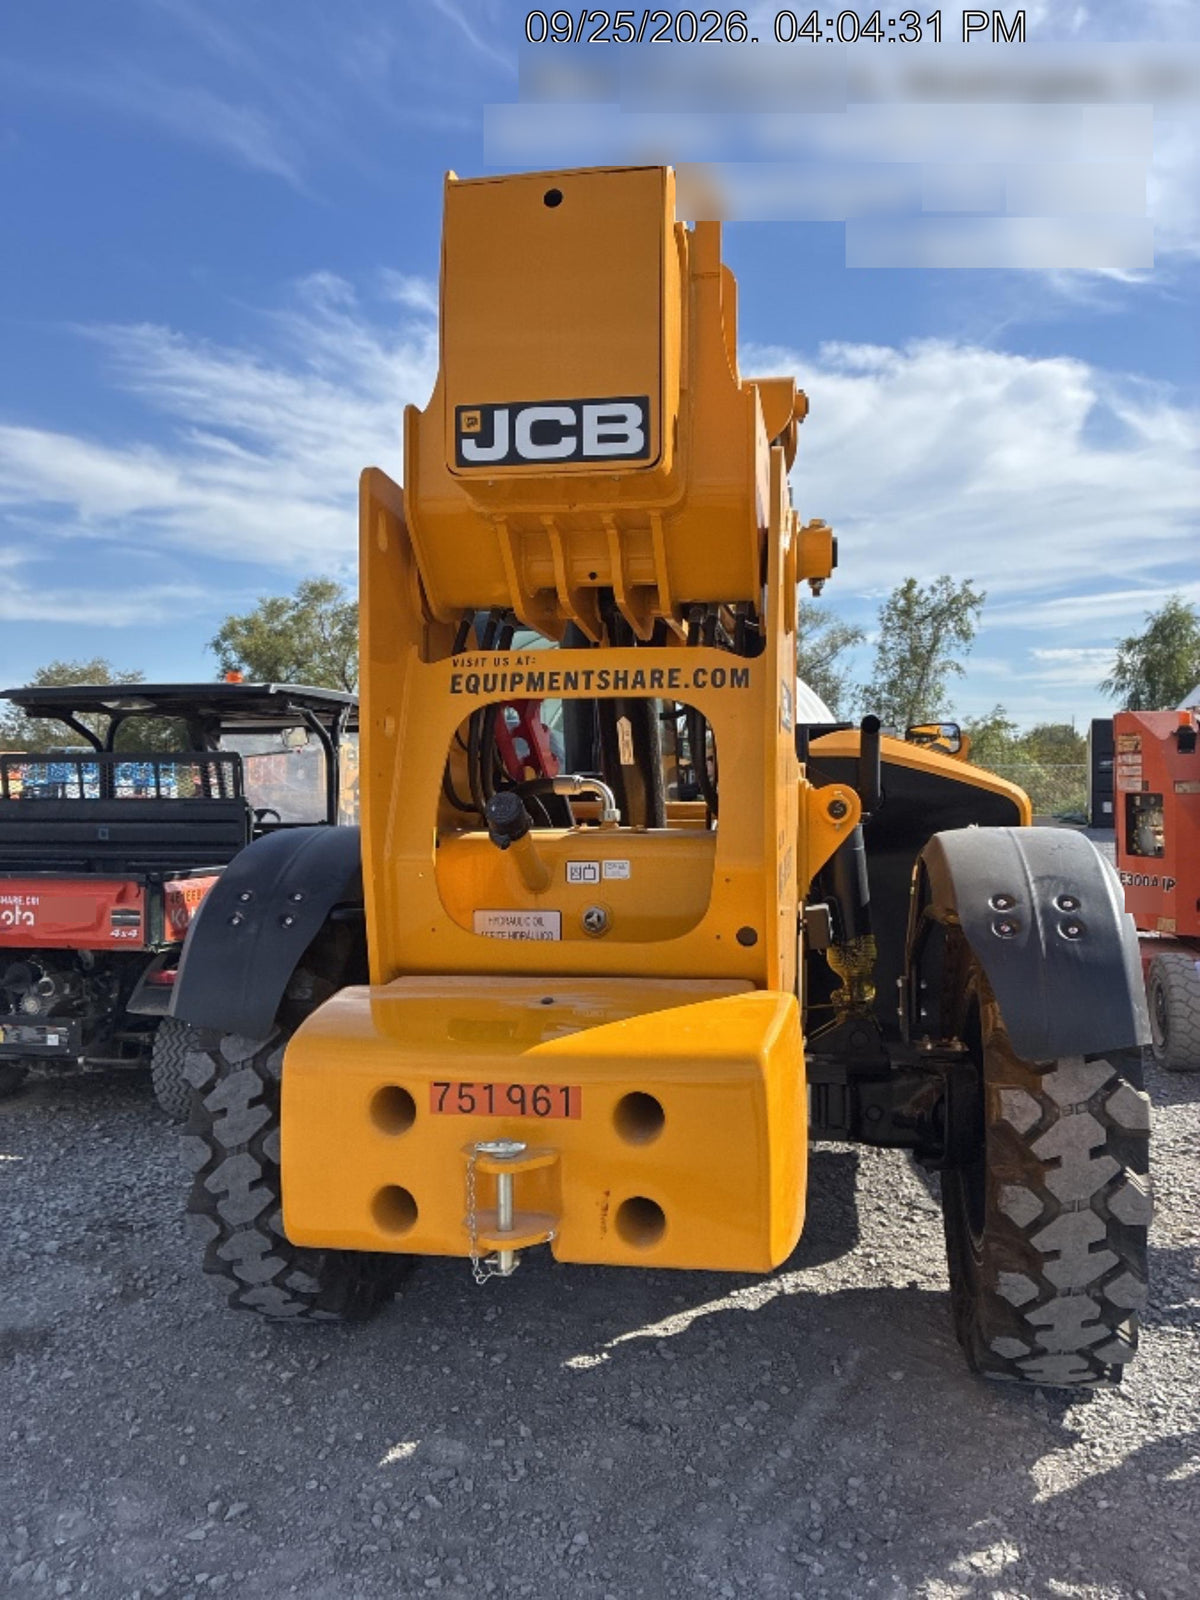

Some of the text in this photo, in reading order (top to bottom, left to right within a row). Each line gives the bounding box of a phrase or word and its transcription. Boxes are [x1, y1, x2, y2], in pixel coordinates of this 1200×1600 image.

[461, 403, 645, 462] JCB
[452, 656, 537, 668] VISIT US AT:
[450, 667, 750, 695] EQUIPMENTSHARE.COM
[1, 904, 34, 925] ota
[433, 1082, 571, 1116] 751961
